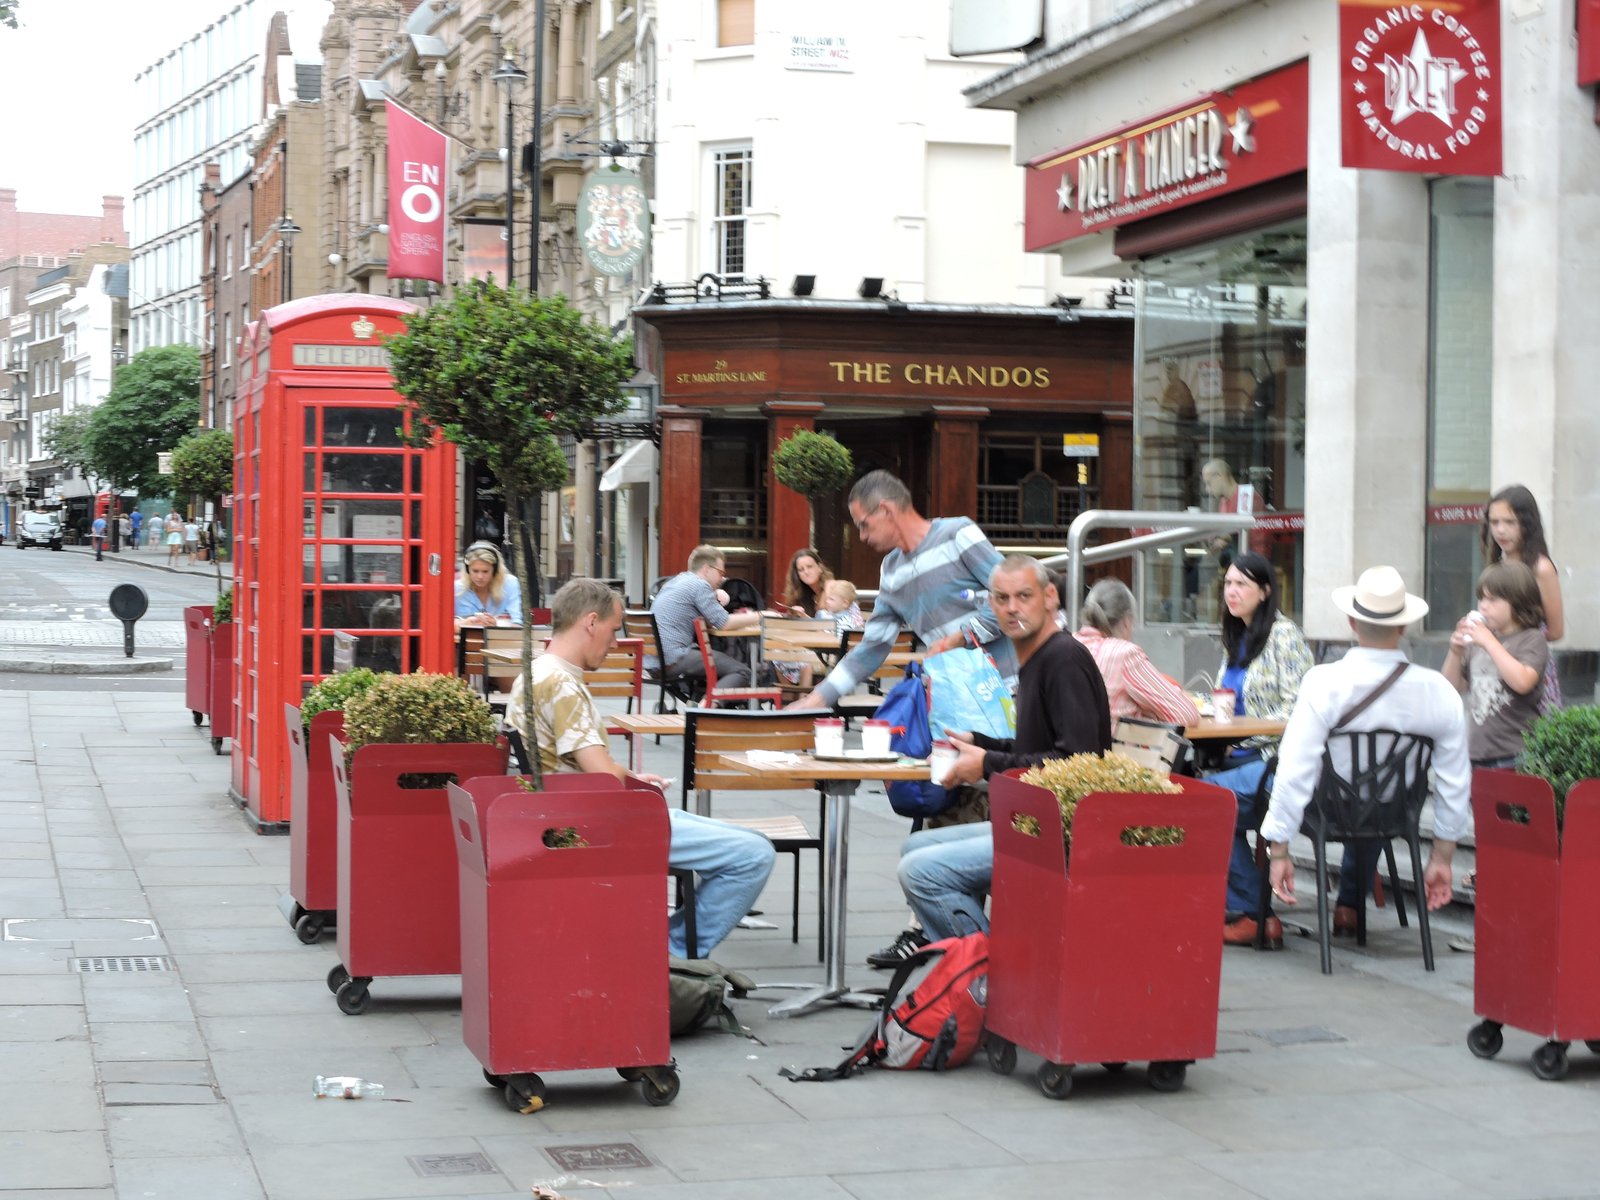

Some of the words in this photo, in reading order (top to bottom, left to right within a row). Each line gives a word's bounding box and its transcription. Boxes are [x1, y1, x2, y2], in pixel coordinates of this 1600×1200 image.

[791, 47, 825, 57] STREET
[1351, 4, 1424, 72] ORGANIC
[1431, 8, 1491, 80] COFFEE
[1384, 52, 1460, 115] PRET
[1356, 100, 1442, 161] NATURAL
[1445, 105, 1486, 154] FOOD
[403, 161, 439, 186] EN
[1078, 145, 1119, 213] PRET
[1124, 139, 1140, 199] A
[1144, 108, 1230, 193] MANGER
[401, 184, 441, 223] O
[300, 347, 393, 366] TELEPHO
[740, 371, 767, 382] LANE
[829, 361, 892, 384] THE
[904, 363, 1050, 388] CHANDOS
